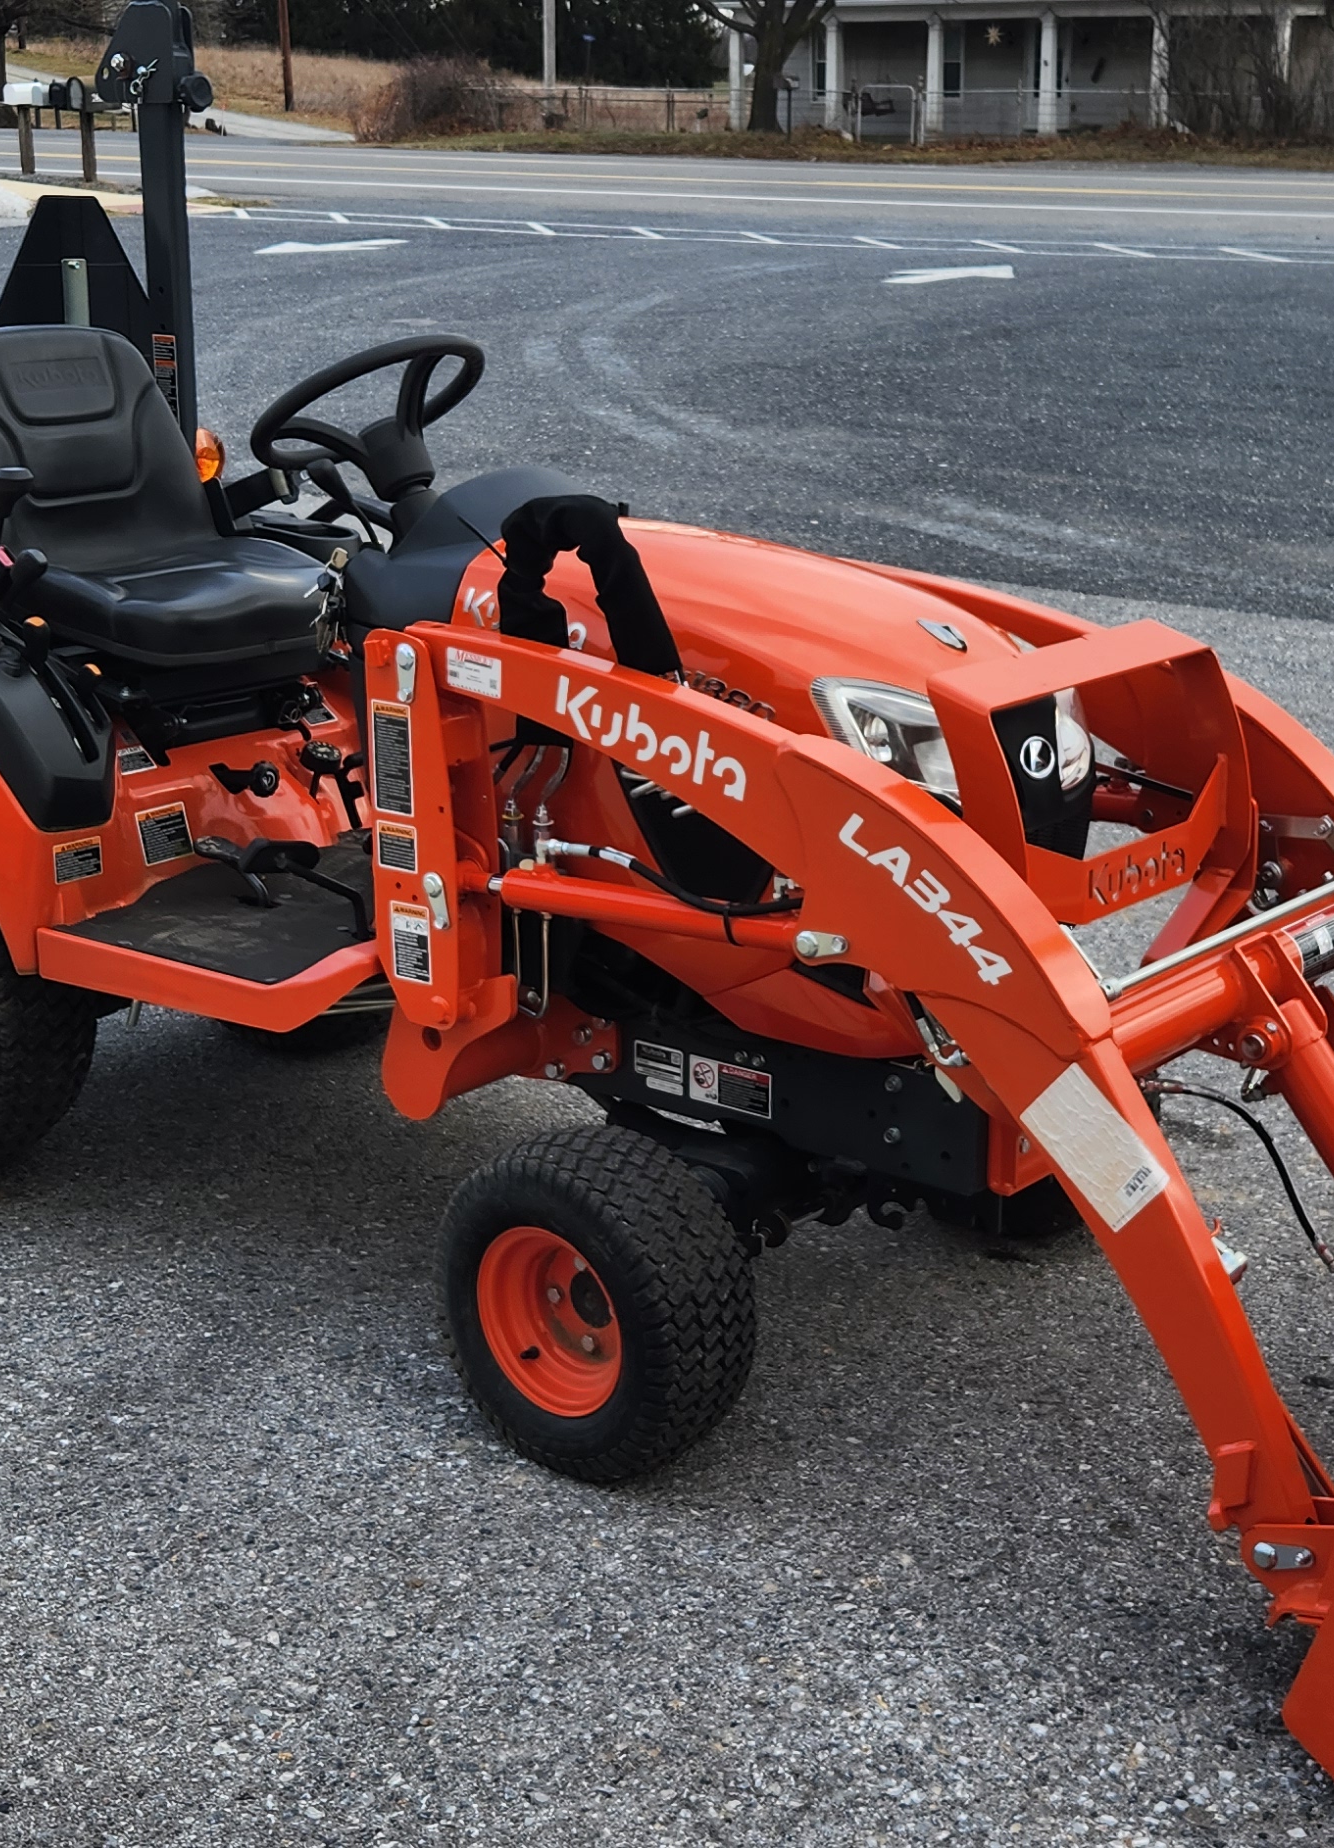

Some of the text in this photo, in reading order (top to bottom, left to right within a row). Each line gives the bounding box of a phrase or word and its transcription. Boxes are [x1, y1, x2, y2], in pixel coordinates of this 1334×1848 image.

[555, 675, 746, 801] Kubota
[838, 812, 1013, 986] LA344
[1088, 841, 1185, 905] Kubota
